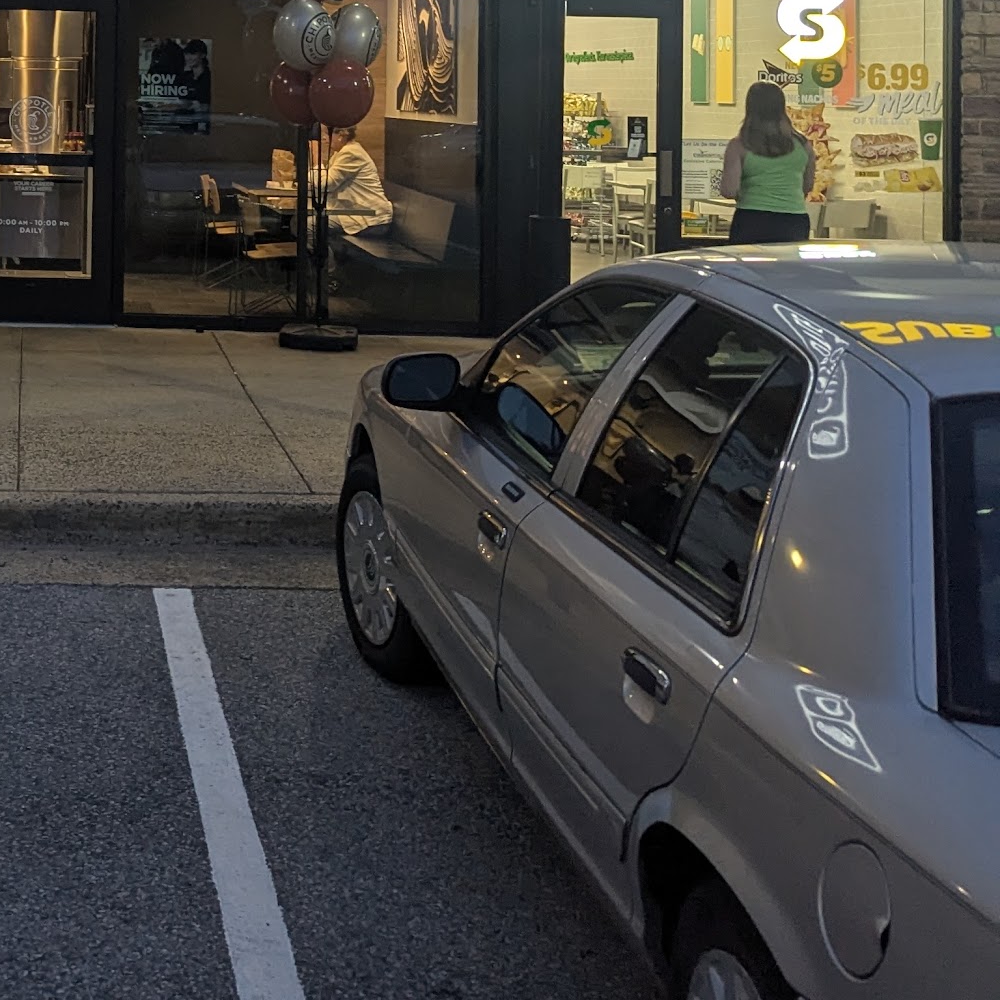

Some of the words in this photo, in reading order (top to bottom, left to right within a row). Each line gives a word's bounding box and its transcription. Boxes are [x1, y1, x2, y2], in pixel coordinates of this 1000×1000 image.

[141, 73, 176, 84] NOW
[759, 70, 803, 84] Doritos
[816, 62, 836, 83] $5
[857, 62, 929, 91] $6.99
[141, 84, 188, 96] HIRING
[879, 81, 944, 119] meal
